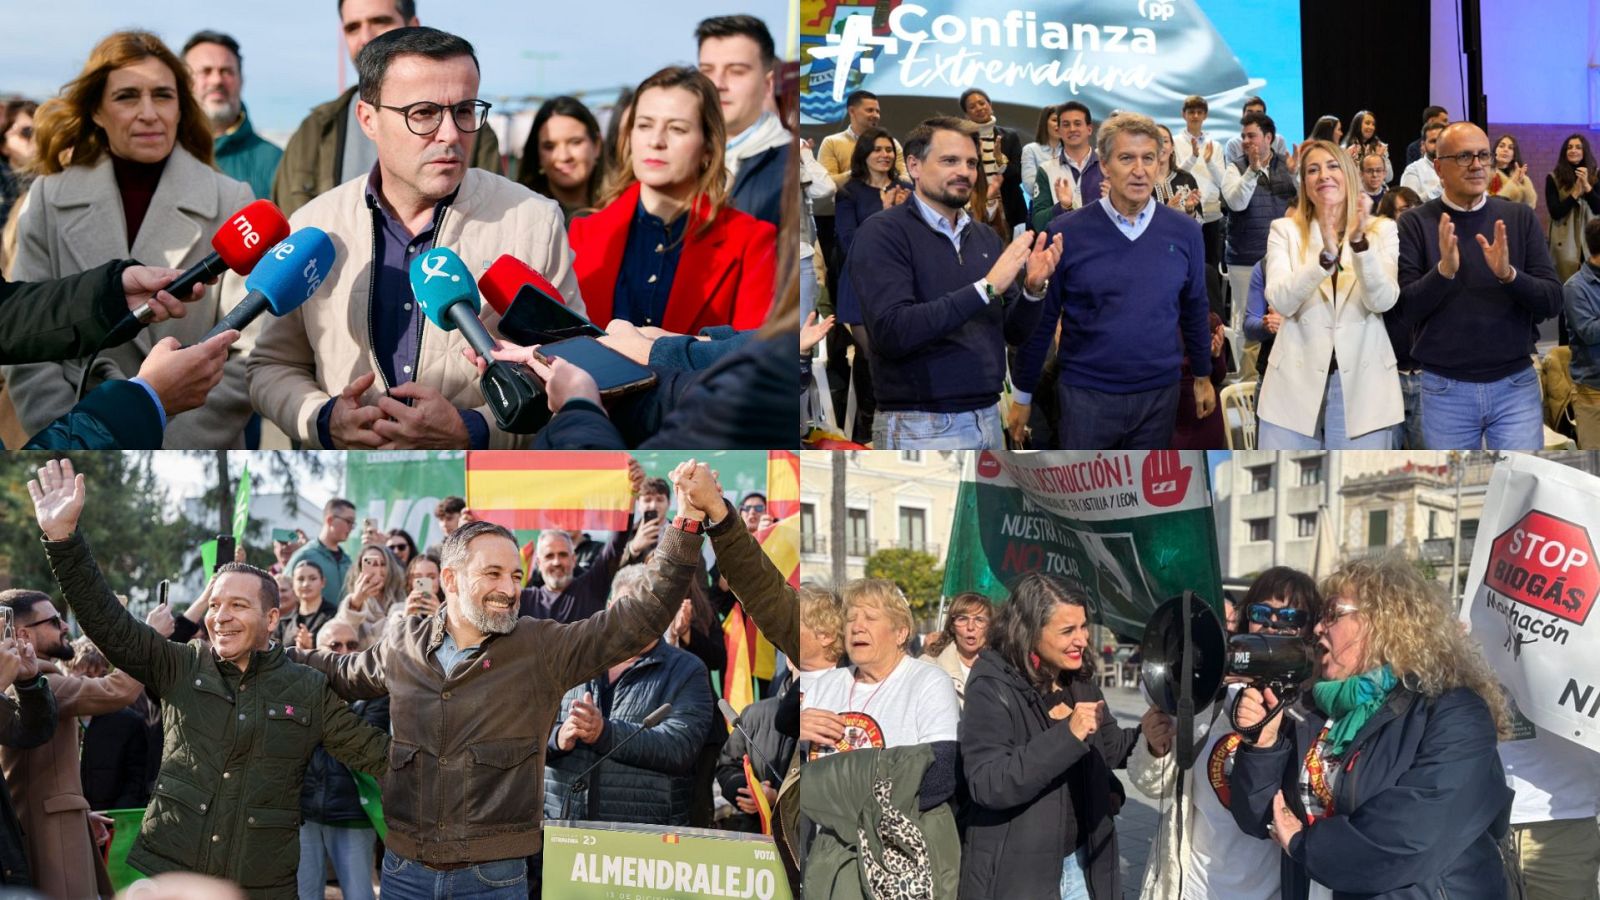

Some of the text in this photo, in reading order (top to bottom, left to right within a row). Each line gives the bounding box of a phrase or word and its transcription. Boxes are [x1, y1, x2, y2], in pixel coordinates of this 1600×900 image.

[889, 3, 1157, 54] Confianza
[898, 40, 1158, 95] Extremadura
[233, 215, 260, 249] rne
[267, 242, 295, 260] ve
[1001, 513, 1058, 543] NUESTRA
[1003, 541, 1044, 574] NO
[1509, 528, 1588, 573] STOP
[1494, 559, 1586, 613] BIOGÁS
[754, 849, 776, 861] VOTA
[571, 853, 775, 899] ALMENDRALEJO
